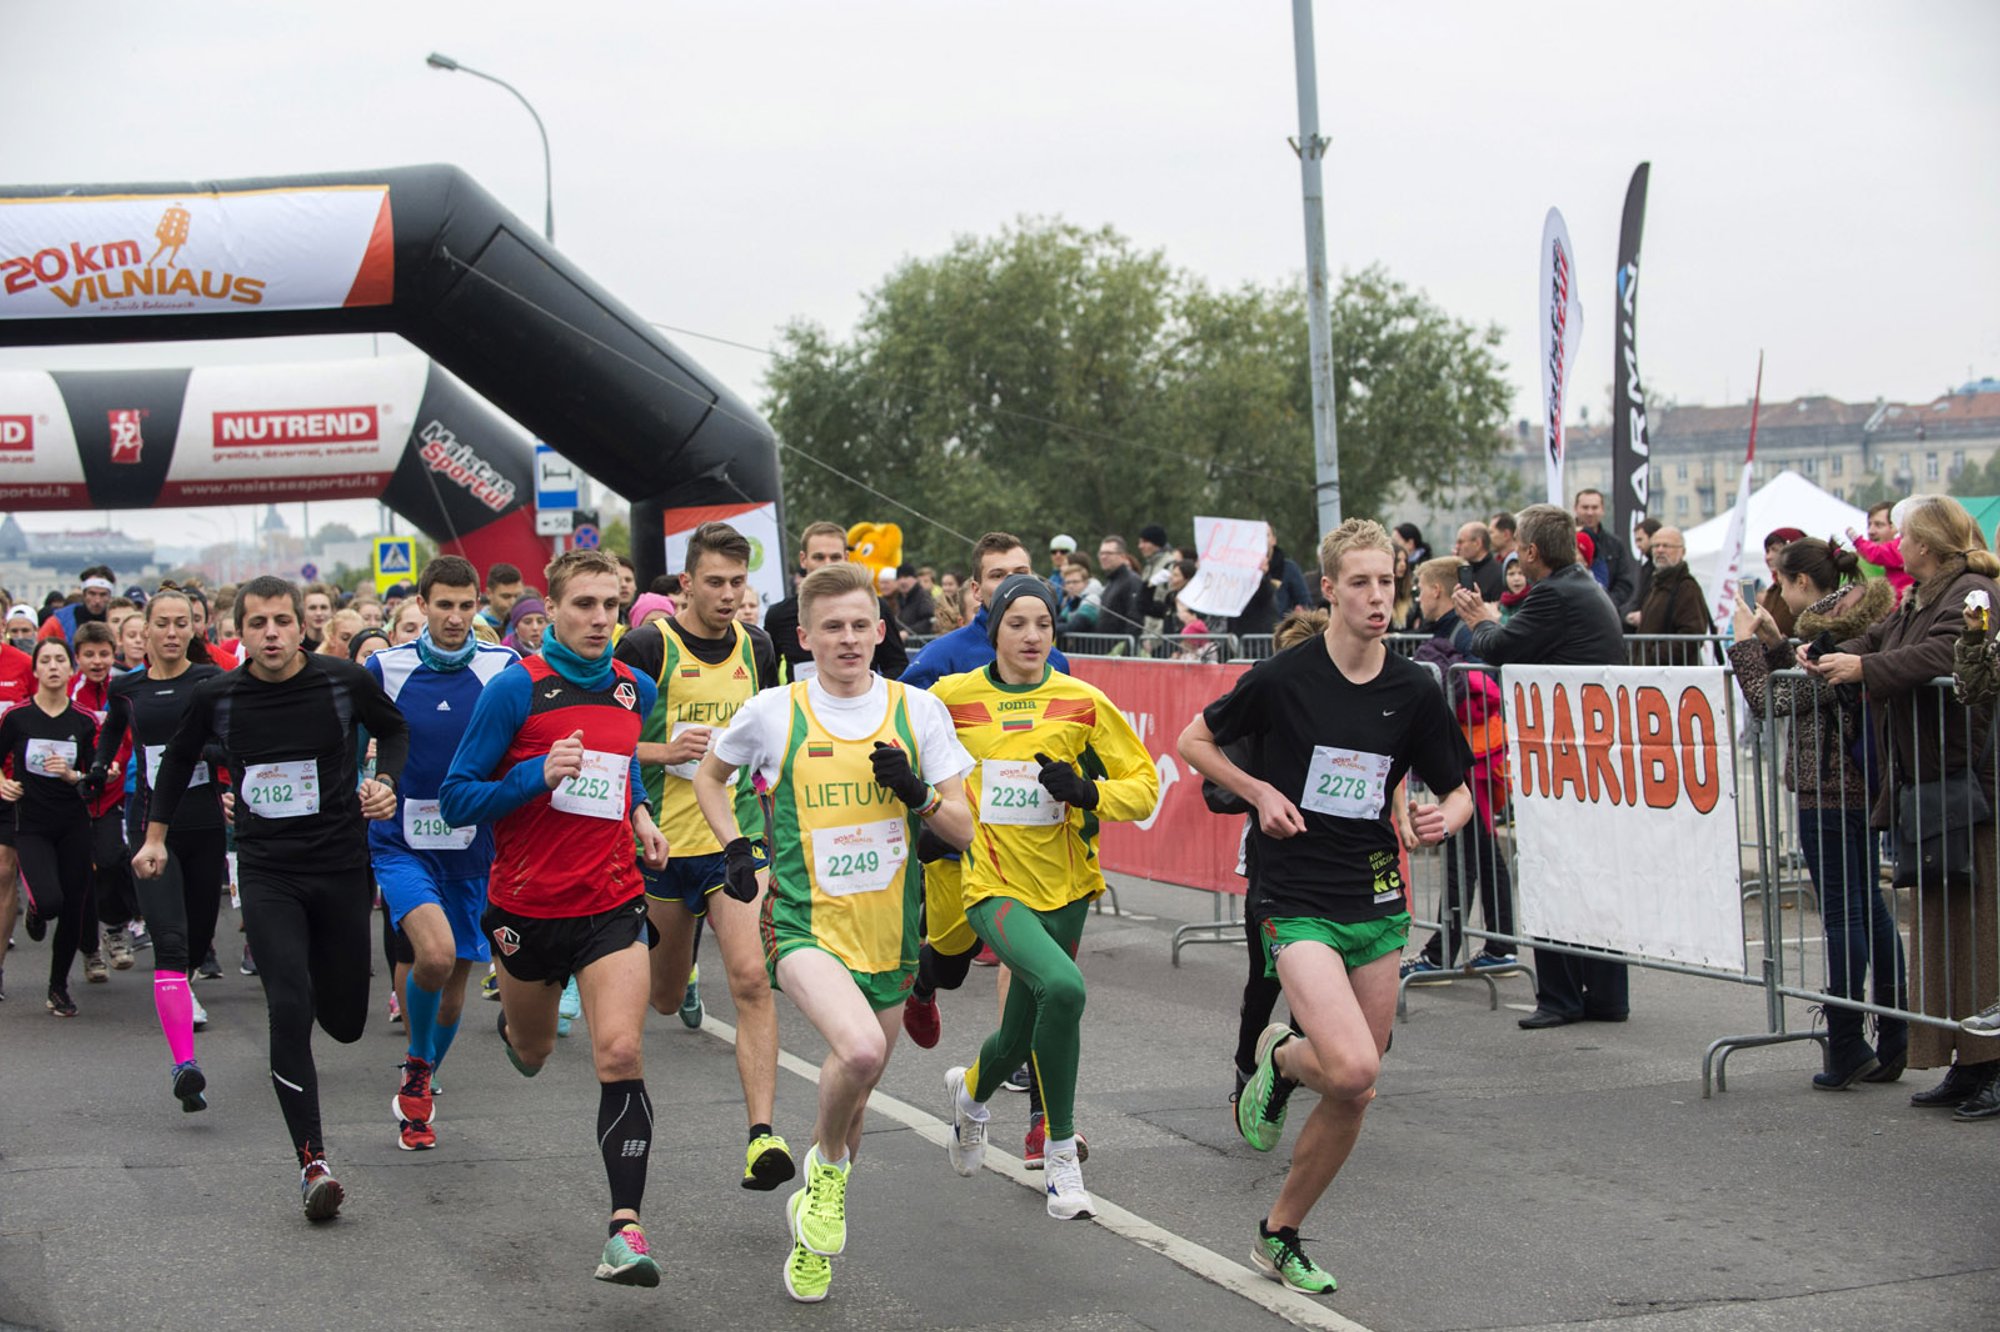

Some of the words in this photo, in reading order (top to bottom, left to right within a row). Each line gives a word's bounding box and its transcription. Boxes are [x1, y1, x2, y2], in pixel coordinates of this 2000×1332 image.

[0, 240, 142, 294] 20km
[50, 268, 266, 308] VILNIAUS
[222, 413, 371, 440] NUTREND
[419, 419, 516, 494] Maistas
[420, 439, 514, 511] Sportui
[677, 703, 744, 722] LIETUV
[1514, 682, 1719, 814] HARIBO
[251, 785, 293, 804] 2182
[565, 777, 610, 800] 2252
[991, 787, 1040, 808] 2234
[1316, 774, 1367, 800] 2278
[827, 851, 879, 877] 2249
